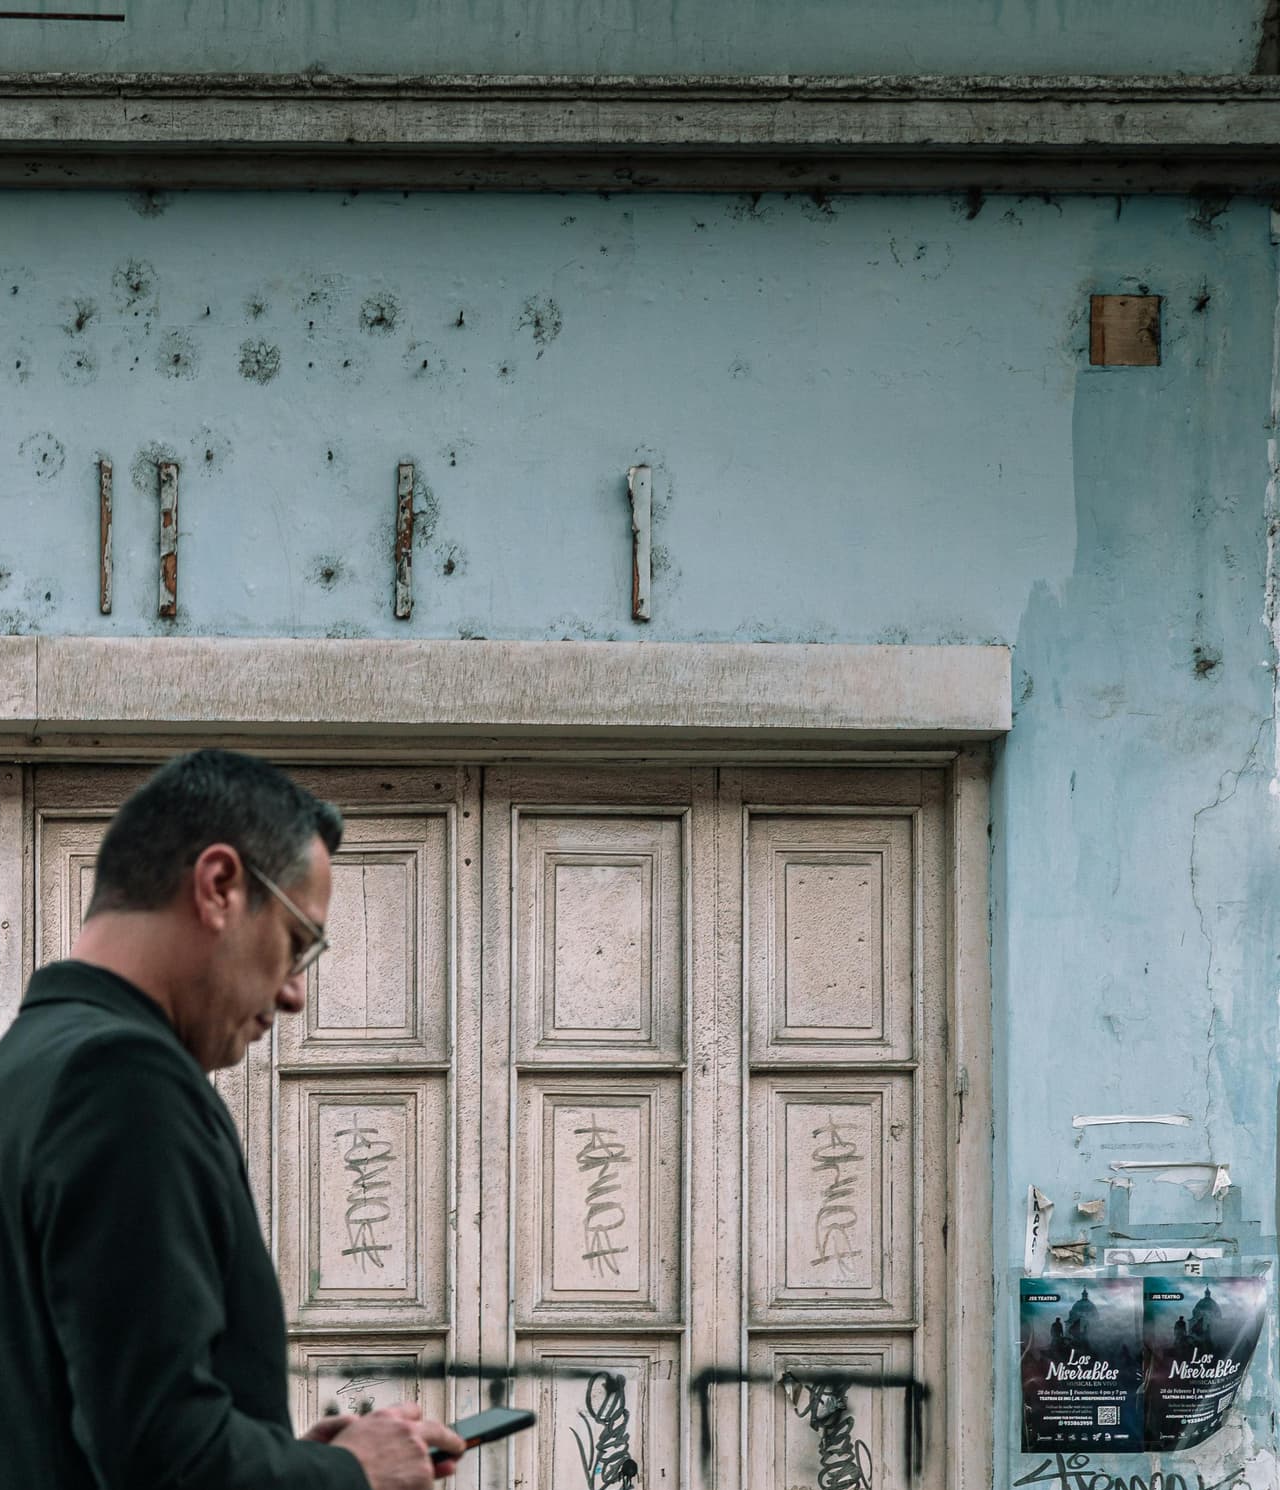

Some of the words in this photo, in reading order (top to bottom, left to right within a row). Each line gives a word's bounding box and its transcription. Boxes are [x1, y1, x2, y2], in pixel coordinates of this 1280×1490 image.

[1068, 1349, 1091, 1366] Los
[1190, 1347, 1213, 1365] Los
[1045, 1361, 1119, 1381] Miserables
[1168, 1359, 1240, 1380] Miserables
